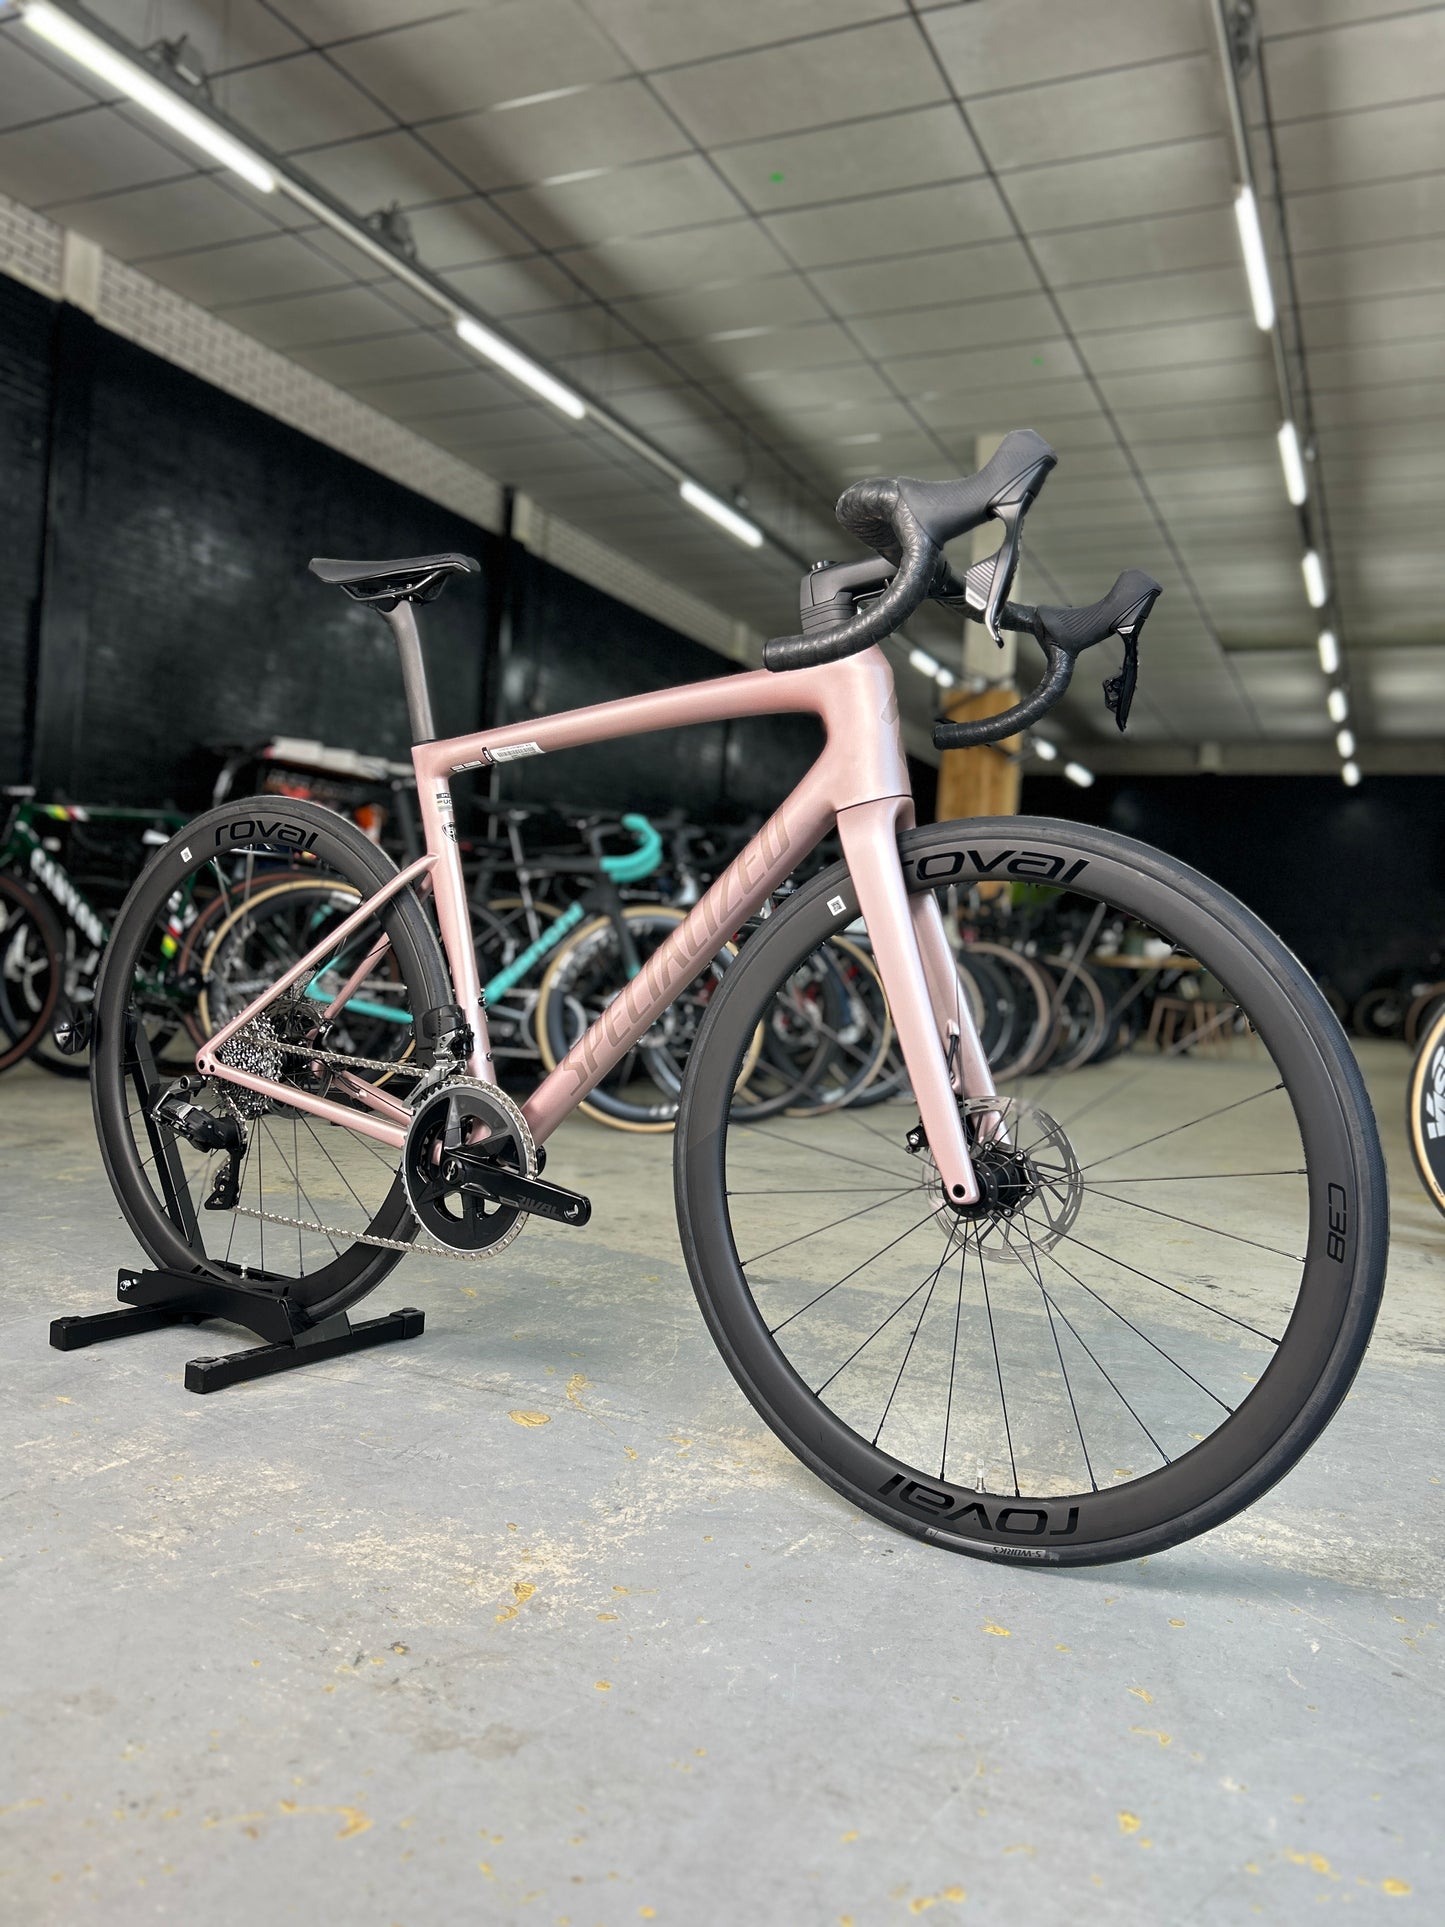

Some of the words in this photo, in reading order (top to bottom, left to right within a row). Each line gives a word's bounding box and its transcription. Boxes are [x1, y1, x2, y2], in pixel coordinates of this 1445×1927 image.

[215, 820, 319, 850] roval
[563, 811, 791, 1097] SPECIALIZED
[517, 1194, 561, 1215] RIVAL
[1327, 1182, 1347, 1264] C38
[877, 1473, 1080, 1536] roval
[992, 1545, 1042, 1558] S-WORKS
